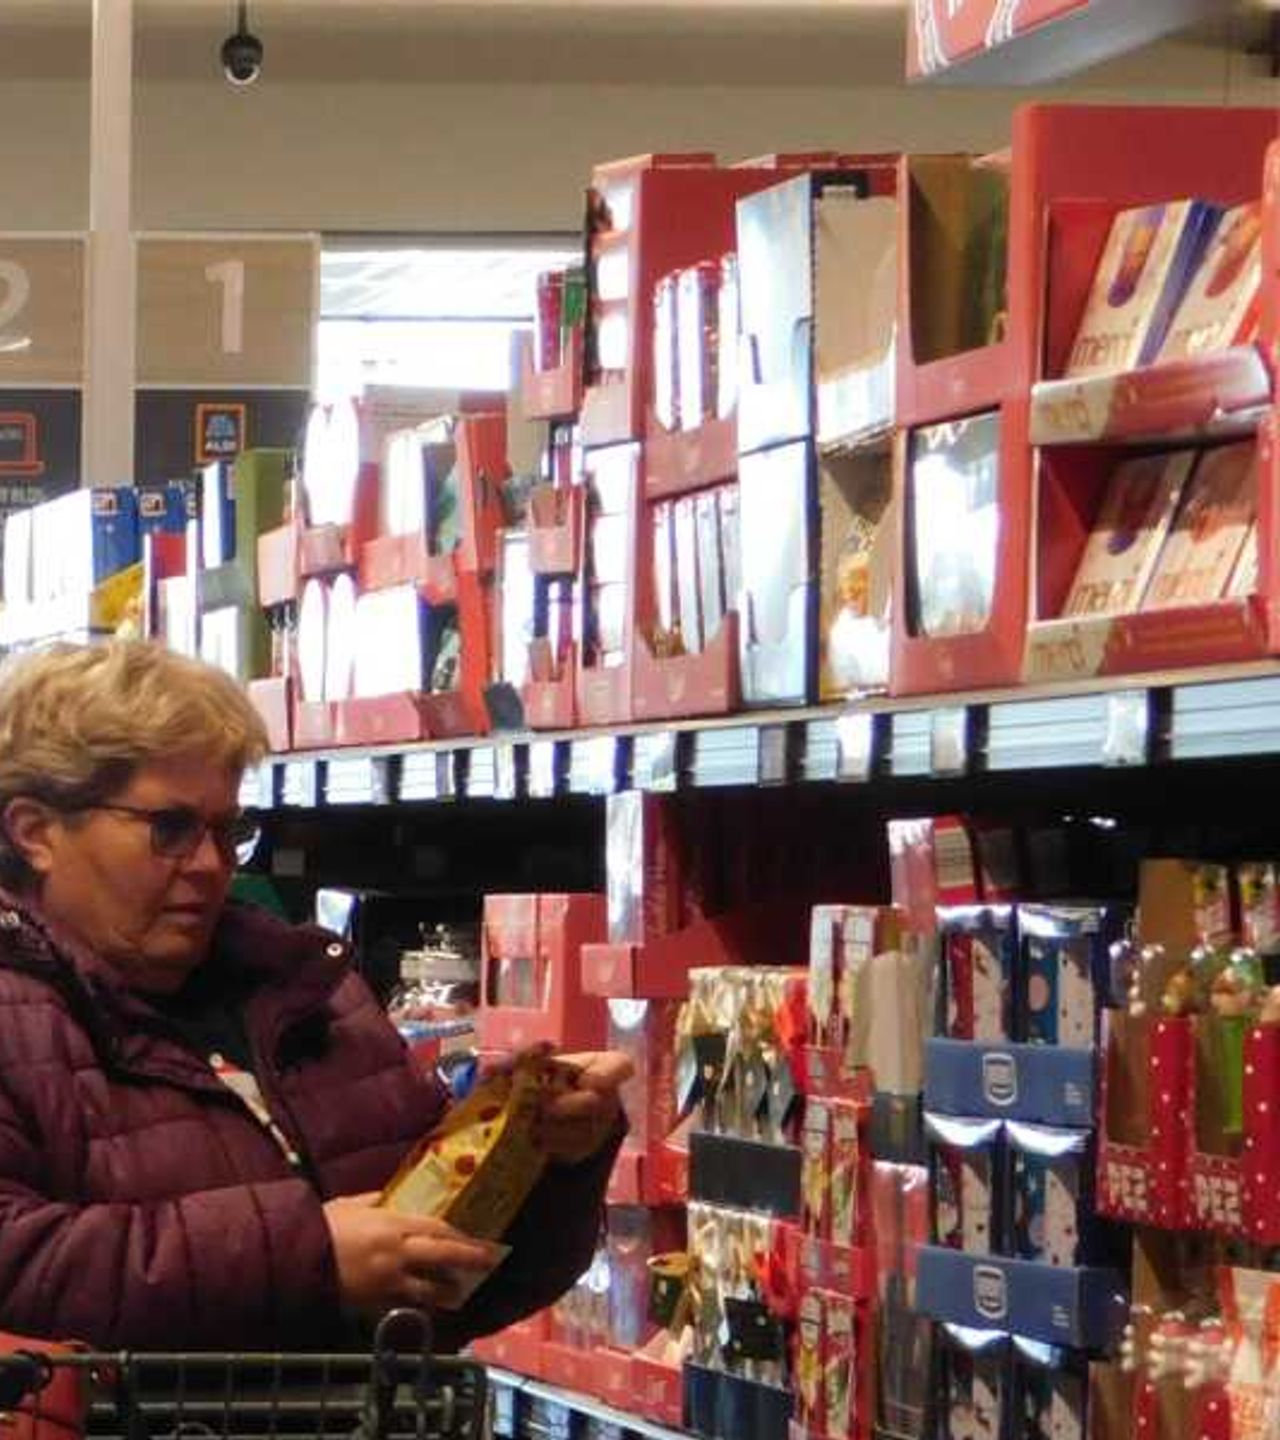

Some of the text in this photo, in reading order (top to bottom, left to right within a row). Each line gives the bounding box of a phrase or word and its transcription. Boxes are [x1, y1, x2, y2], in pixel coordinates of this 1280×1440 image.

[204, 260, 245, 353] 1
[1105, 1161, 1148, 1211] PEZ
[1194, 1172, 1242, 1228] PEZ
